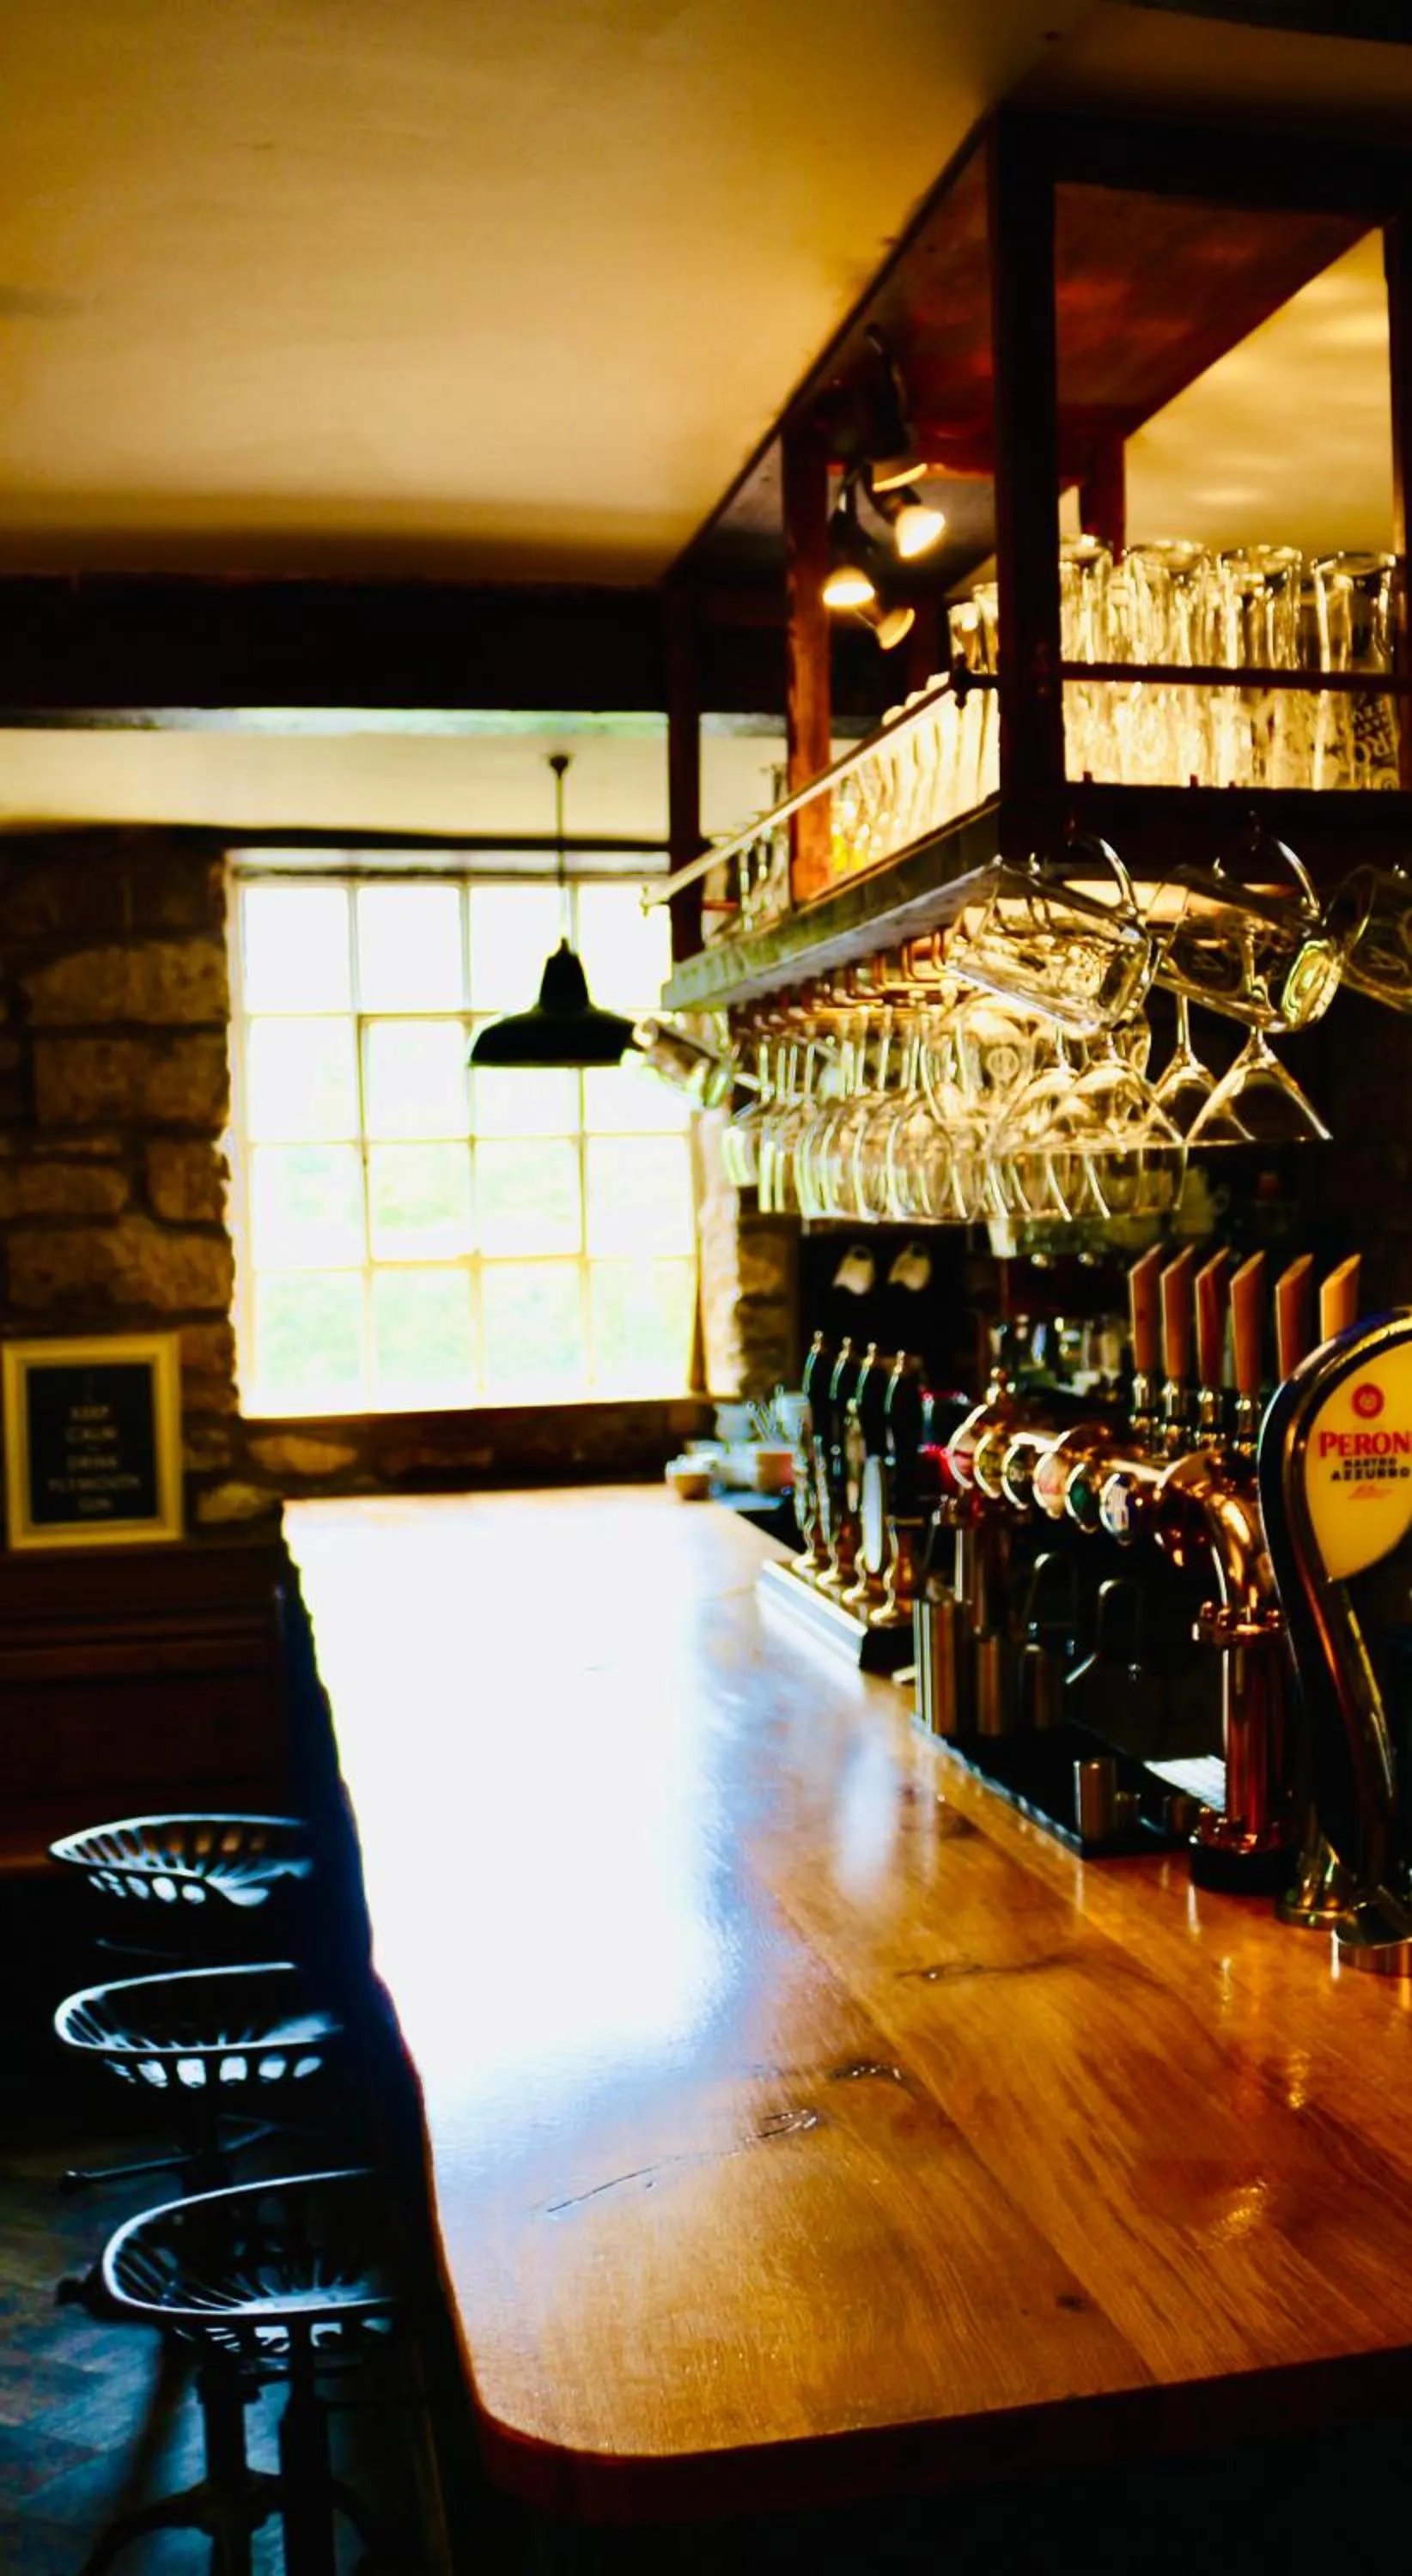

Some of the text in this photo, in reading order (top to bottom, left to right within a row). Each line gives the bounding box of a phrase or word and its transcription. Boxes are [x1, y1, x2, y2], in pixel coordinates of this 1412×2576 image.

[69, 1405, 109, 1419] KEEP
[64, 1425, 117, 1443] CALM
[66, 1454, 118, 1471] DRINK
[46, 1473, 141, 1492] PLYMOUTH
[1331, 1467, 1411, 1481] AZZURRO
